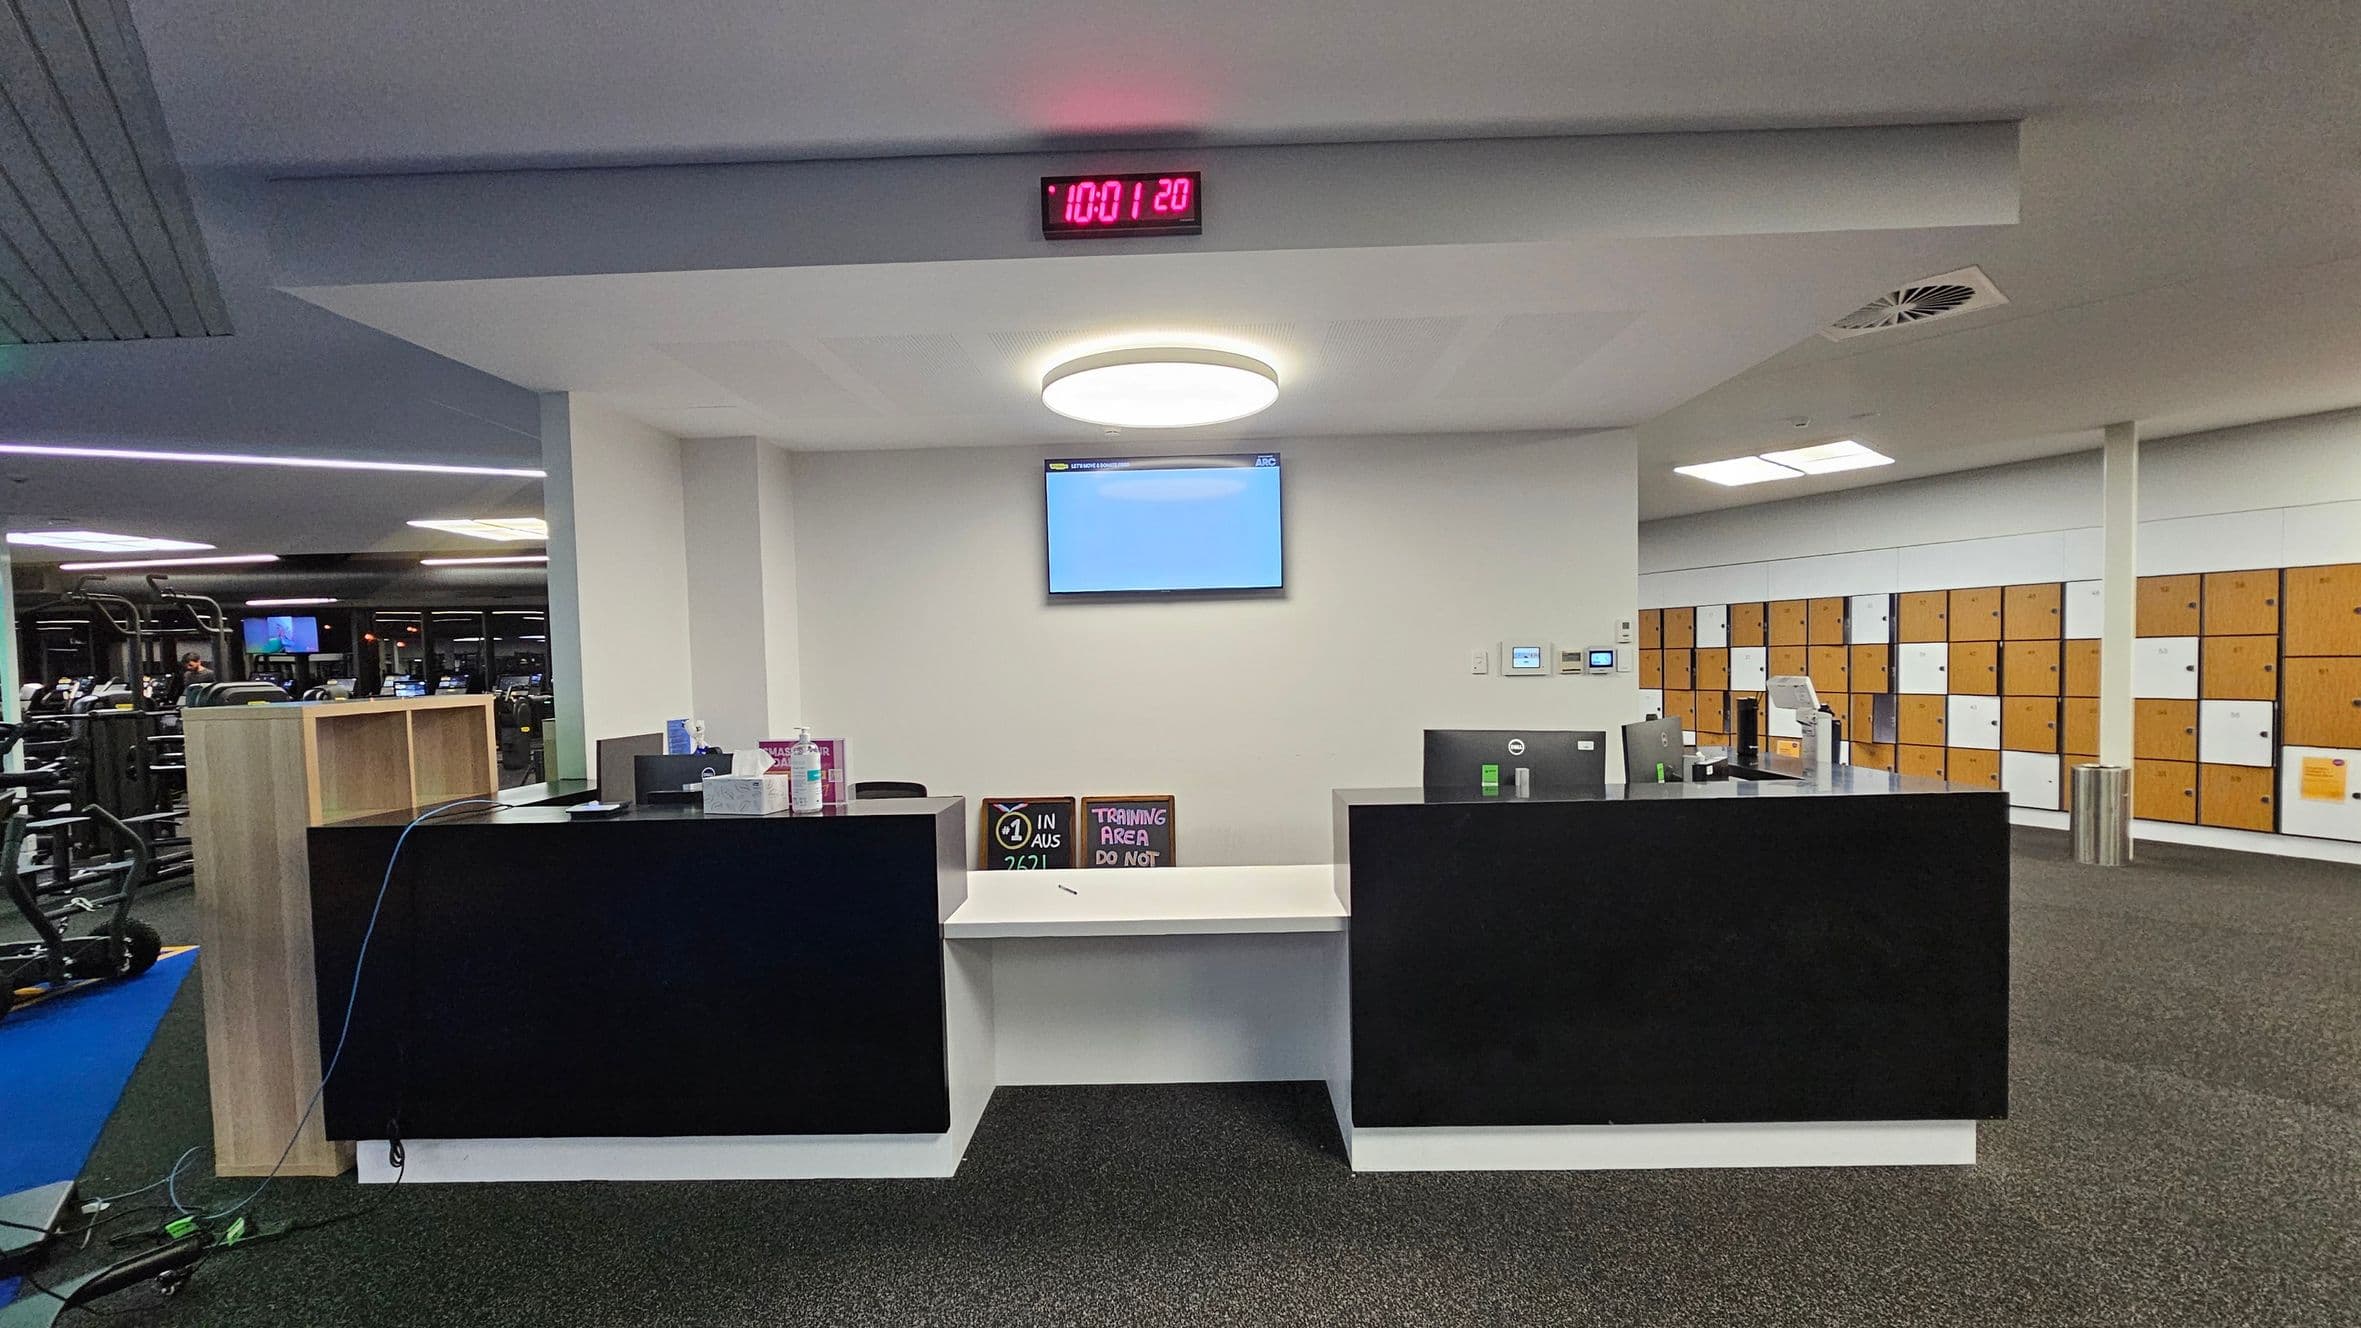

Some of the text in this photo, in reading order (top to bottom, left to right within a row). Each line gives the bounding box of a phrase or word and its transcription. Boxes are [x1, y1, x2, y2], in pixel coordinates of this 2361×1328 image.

[1064, 178, 1190, 223] 10:01 20
[1255, 457, 1276, 467] ARC
[1091, 807, 1167, 826] TRAINING
[1001, 813, 1056, 841] #1 IN
[1101, 825, 1149, 846] AREA
[1030, 833, 1061, 848] AUS
[1095, 850, 1160, 867] DO NOT
